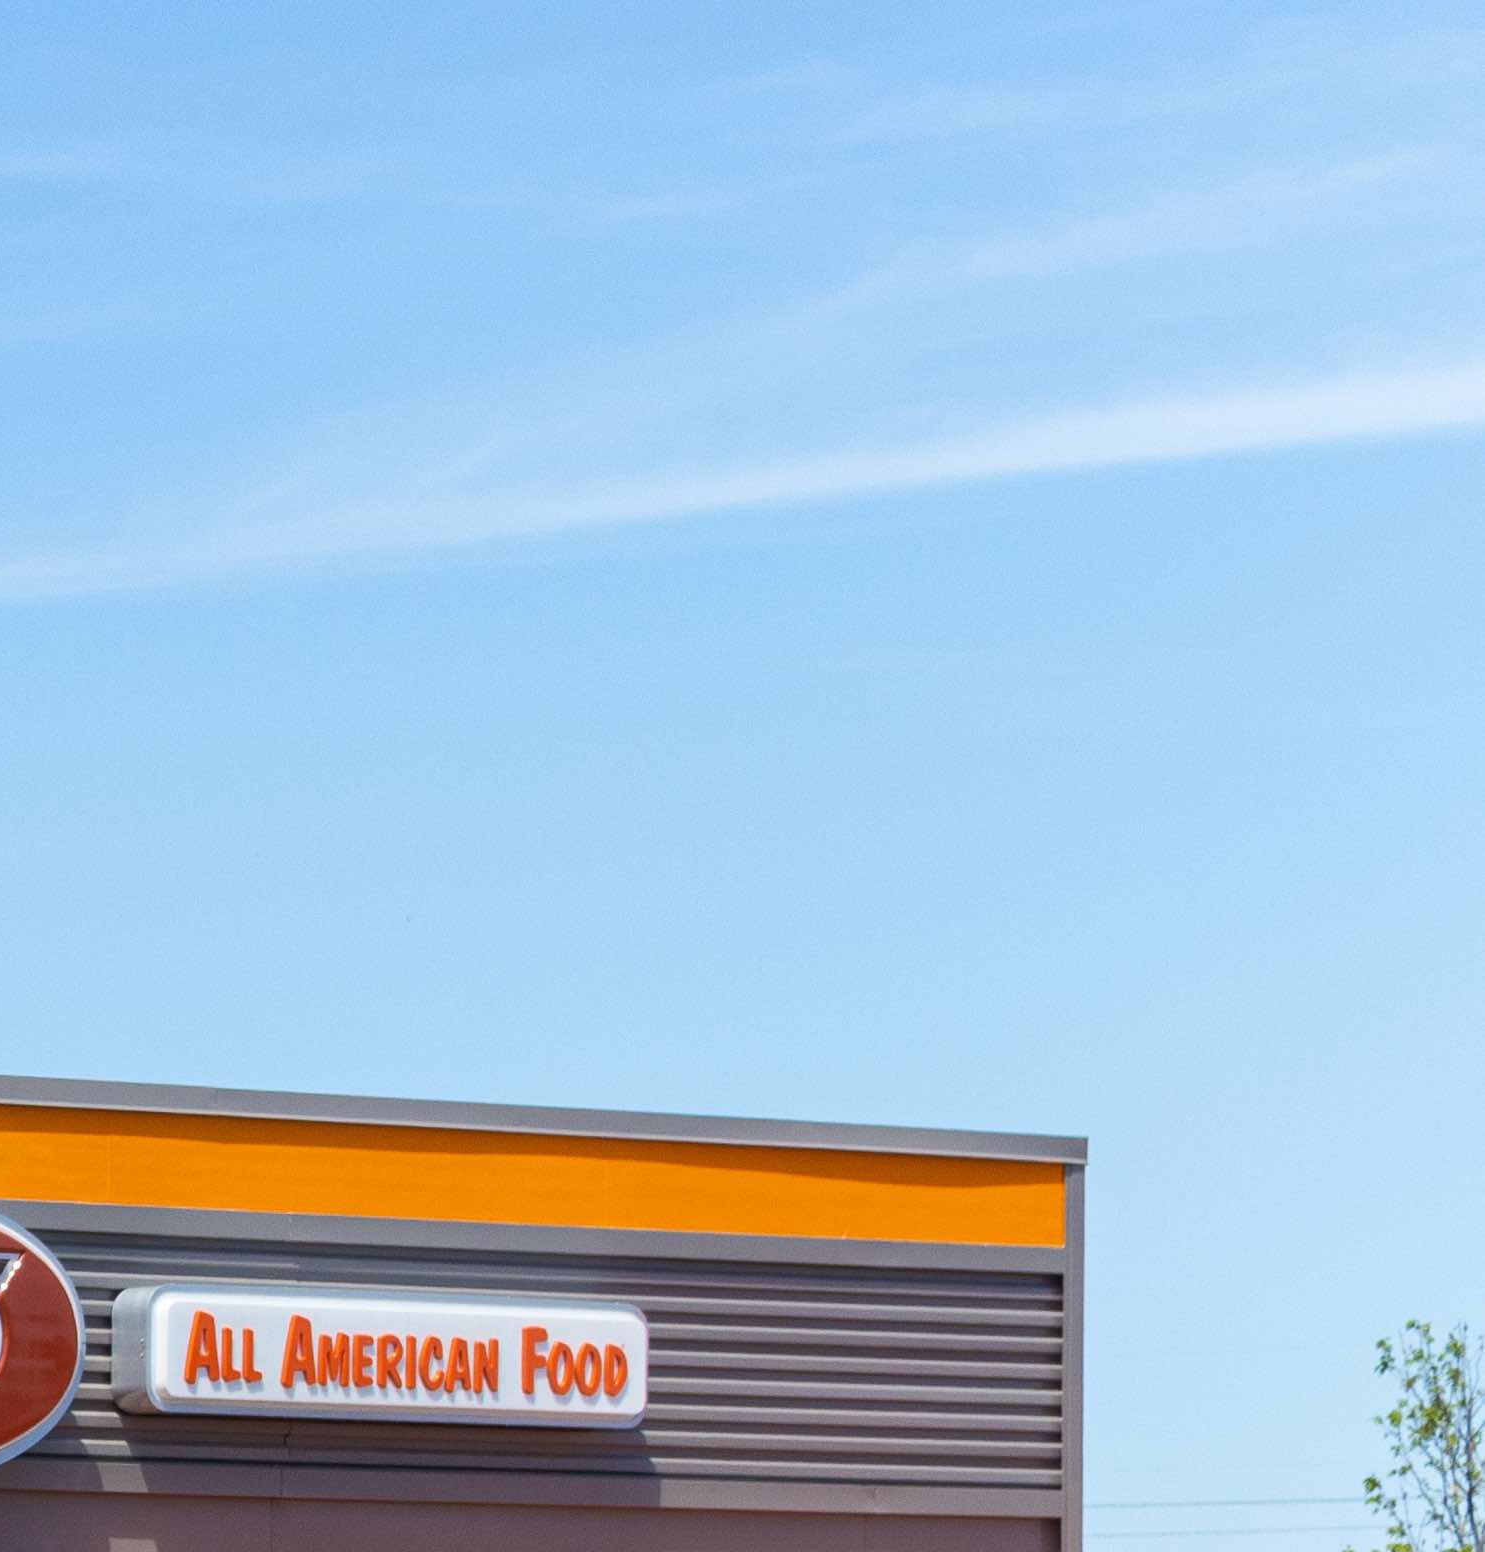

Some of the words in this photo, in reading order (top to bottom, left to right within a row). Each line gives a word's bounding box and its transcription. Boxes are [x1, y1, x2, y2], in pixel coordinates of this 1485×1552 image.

[183, 1309, 263, 1386] ALL
[280, 1312, 500, 1396] AMERICAN
[518, 1325, 630, 1400] FOOD
